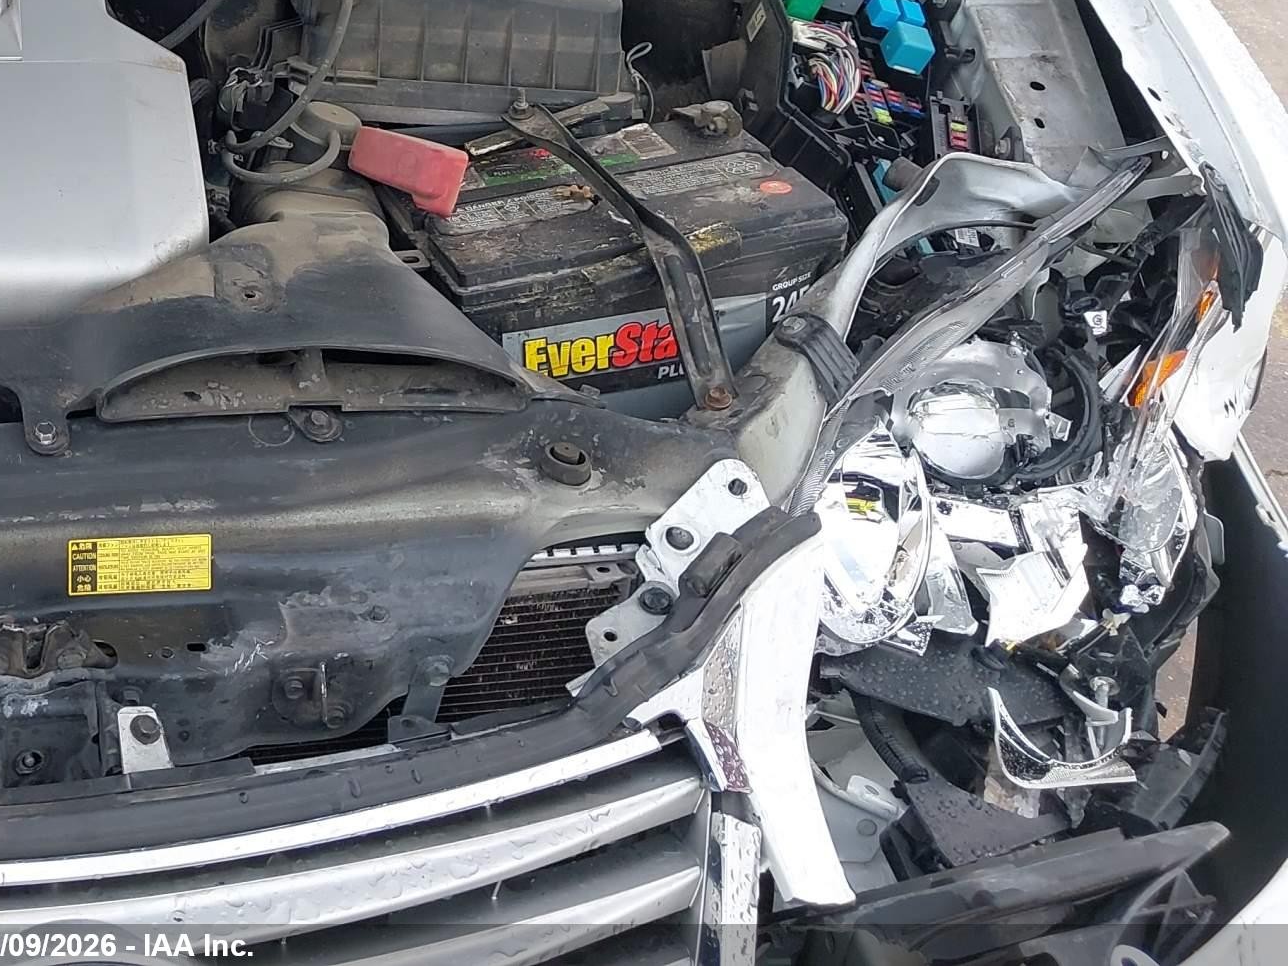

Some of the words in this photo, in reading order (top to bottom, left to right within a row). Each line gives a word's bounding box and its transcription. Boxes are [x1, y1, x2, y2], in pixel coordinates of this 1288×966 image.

[772, 278, 798, 291] GROUP
[798, 271, 812, 282] SIZE
[72, 552, 97, 561] CAUTION
[72, 564, 97, 572] ATTENTION
